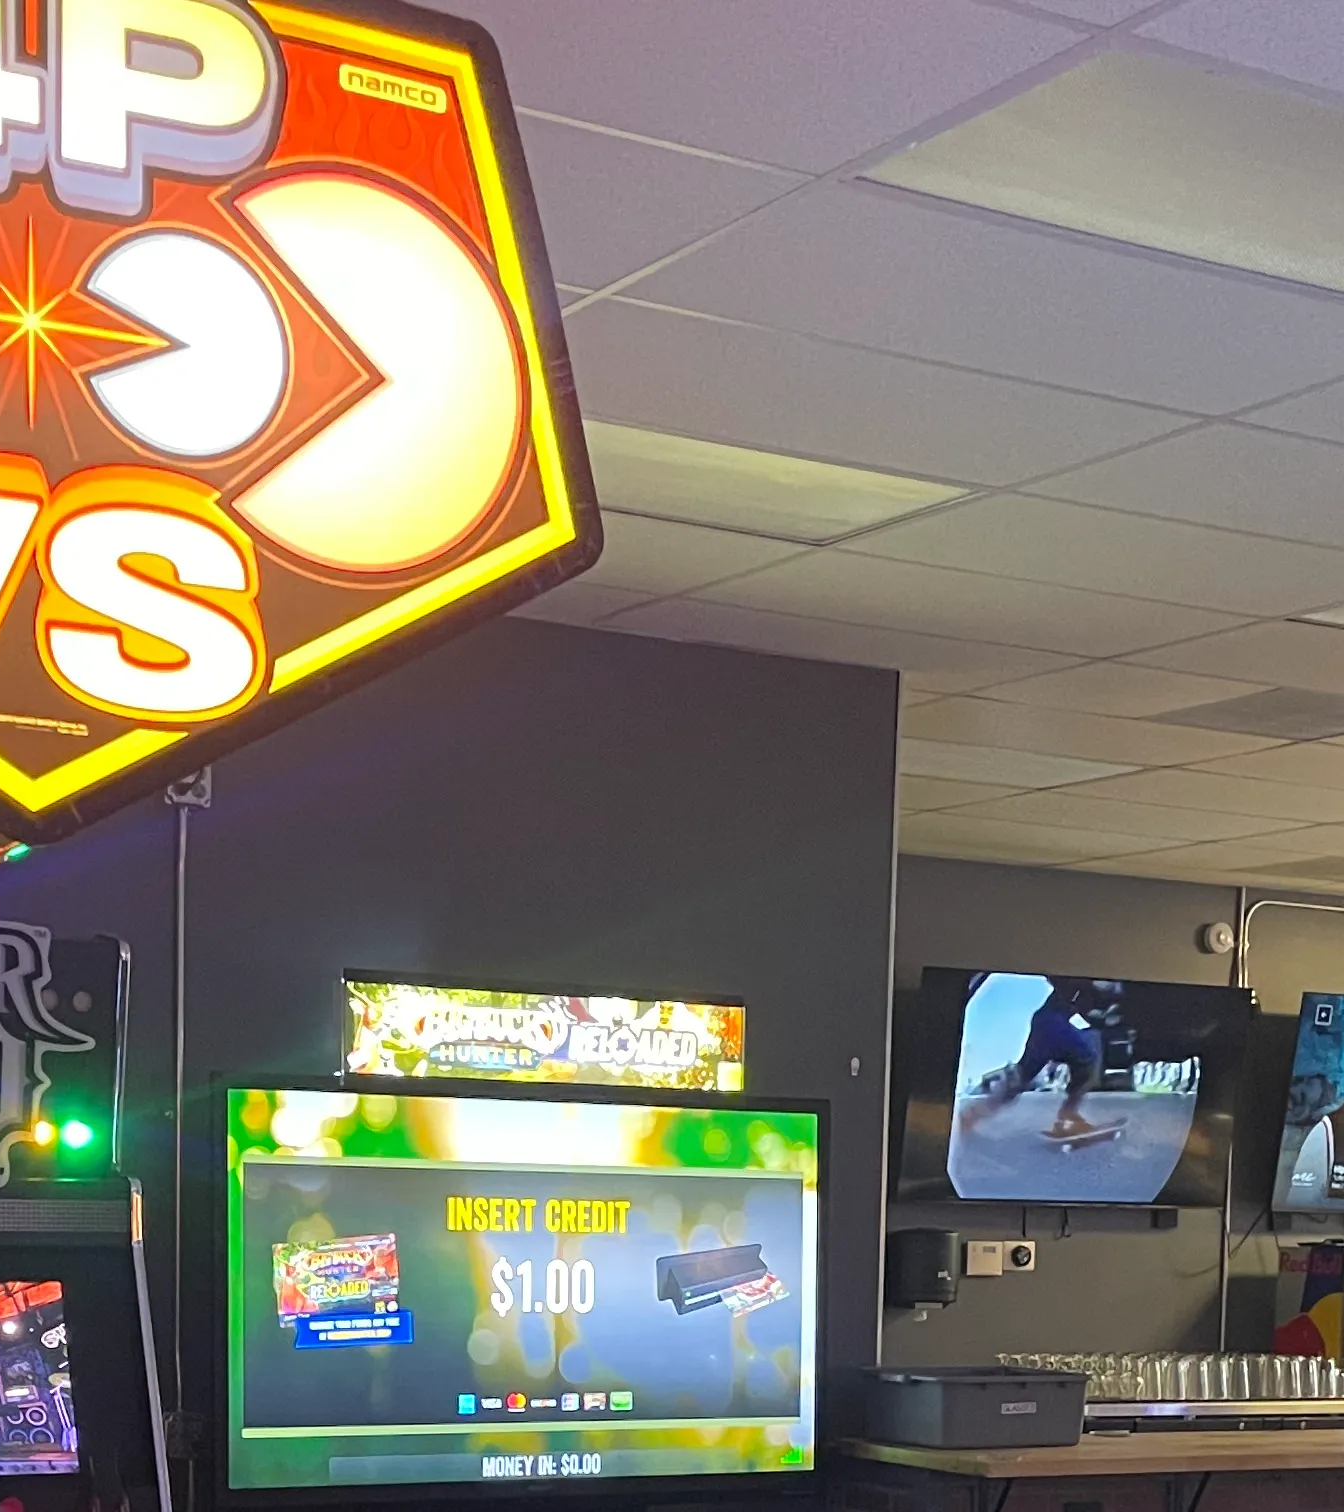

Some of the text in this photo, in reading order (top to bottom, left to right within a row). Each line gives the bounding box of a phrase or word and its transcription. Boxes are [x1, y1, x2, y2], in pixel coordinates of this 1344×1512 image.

[346, 68, 439, 107] namco
[438, 1043, 536, 1067] HUNTER
[568, 1024, 698, 1067] RELOADED
[446, 1196, 631, 1234] INSERT CREDIT
[1280, 1252, 1309, 1273] Red
[490, 1256, 595, 1318] $1.00
[483, 1453, 601, 1477] MONEY IN: $0.00
